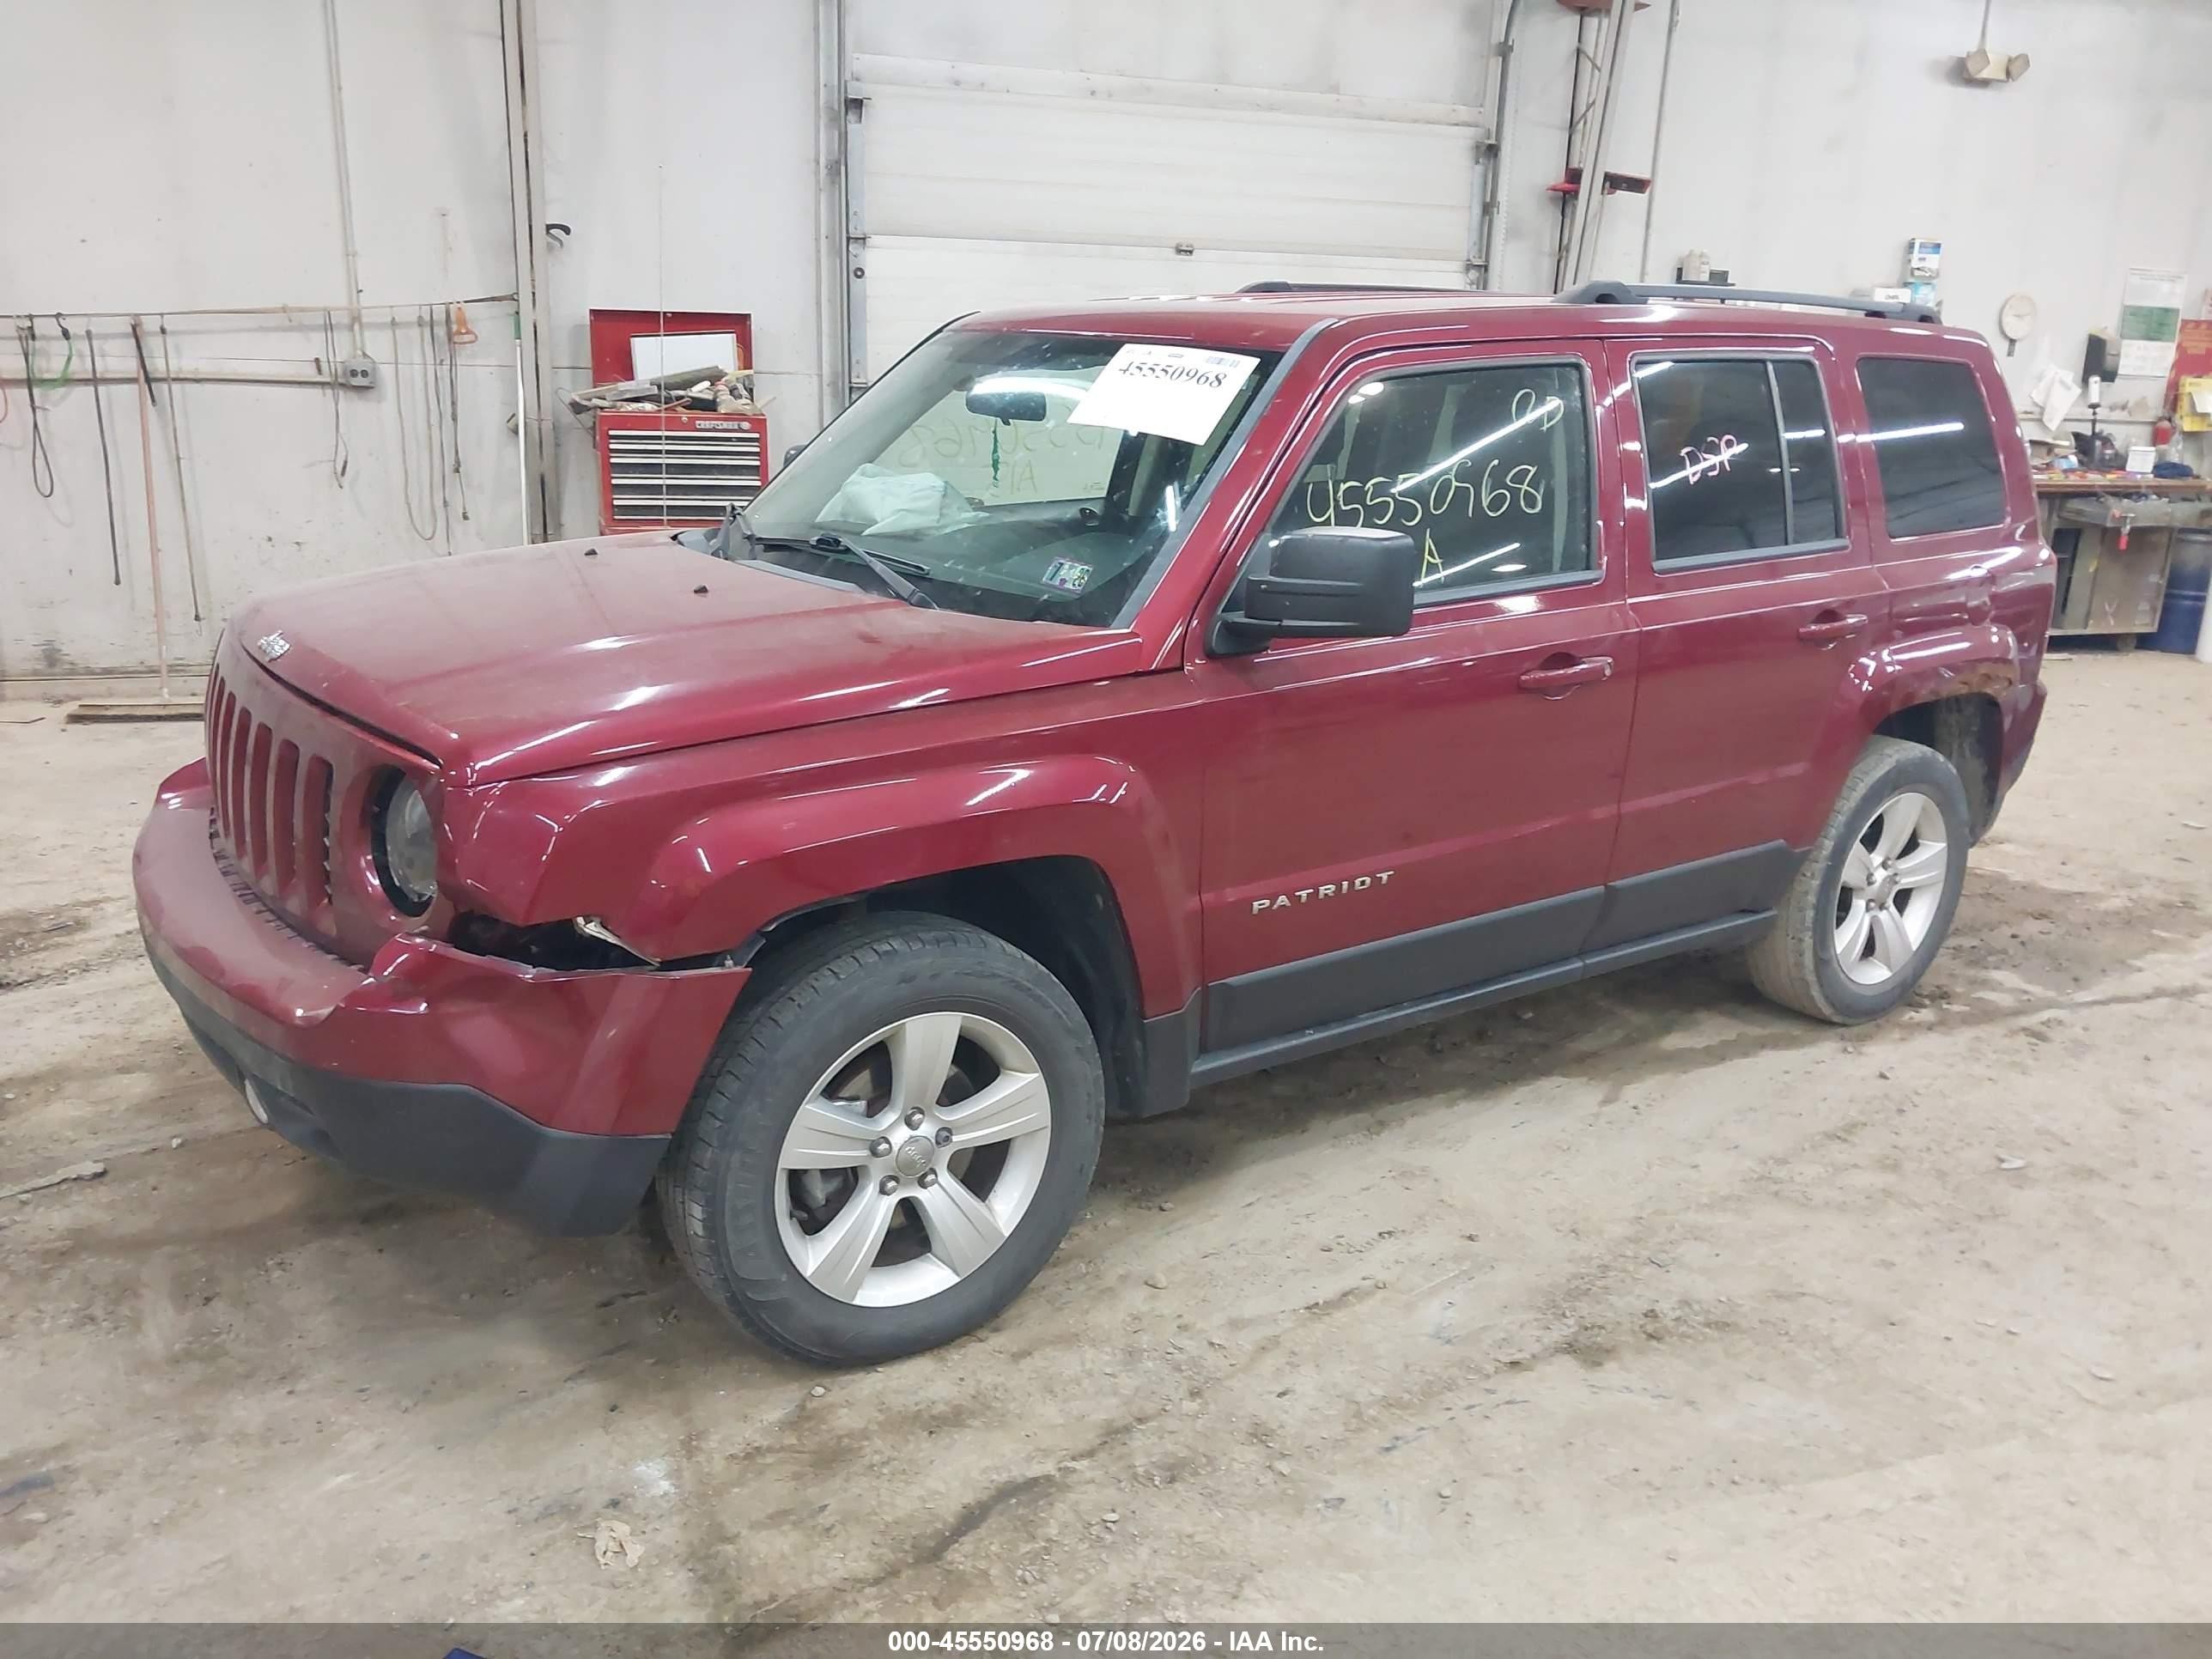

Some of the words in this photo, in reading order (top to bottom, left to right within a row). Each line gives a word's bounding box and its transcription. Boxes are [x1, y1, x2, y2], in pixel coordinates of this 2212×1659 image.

[1119, 360, 1227, 388] 45550968
[1306, 459, 1546, 528] 45550968
[1251, 871, 1395, 915] PATRIOT
